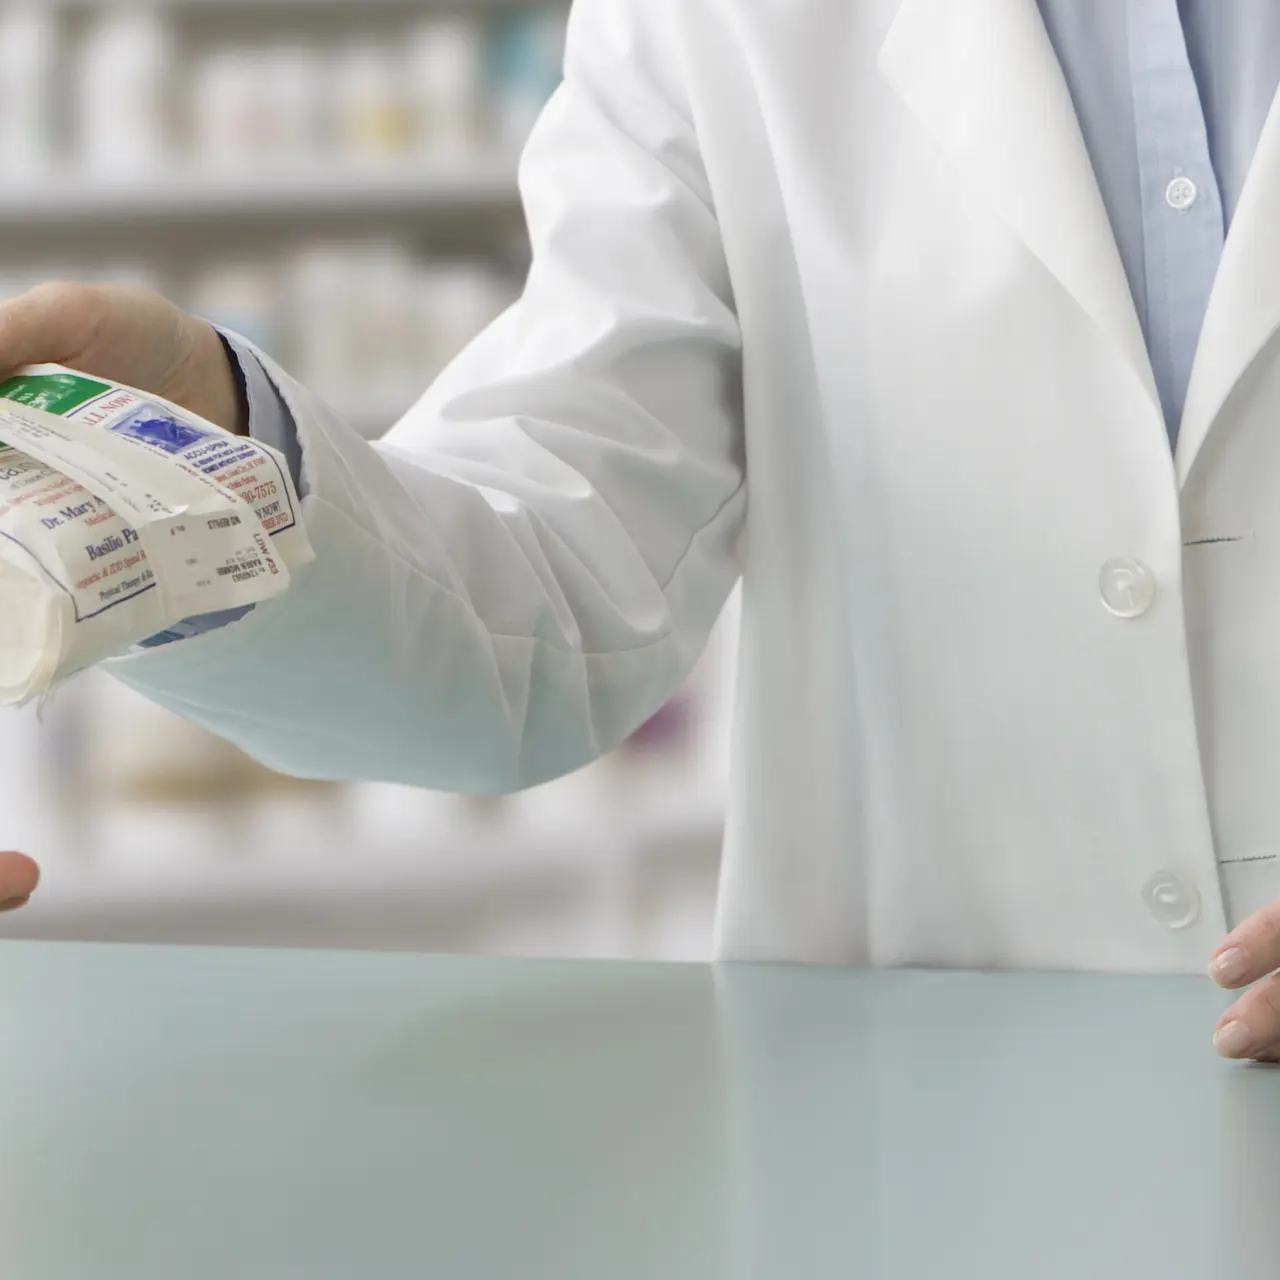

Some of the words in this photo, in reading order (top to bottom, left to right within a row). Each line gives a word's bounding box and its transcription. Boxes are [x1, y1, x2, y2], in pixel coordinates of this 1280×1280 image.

[40, 515, 65, 530] Dr.
[59, 499, 97, 520] Mary
[85, 535, 124, 561] Basilio
